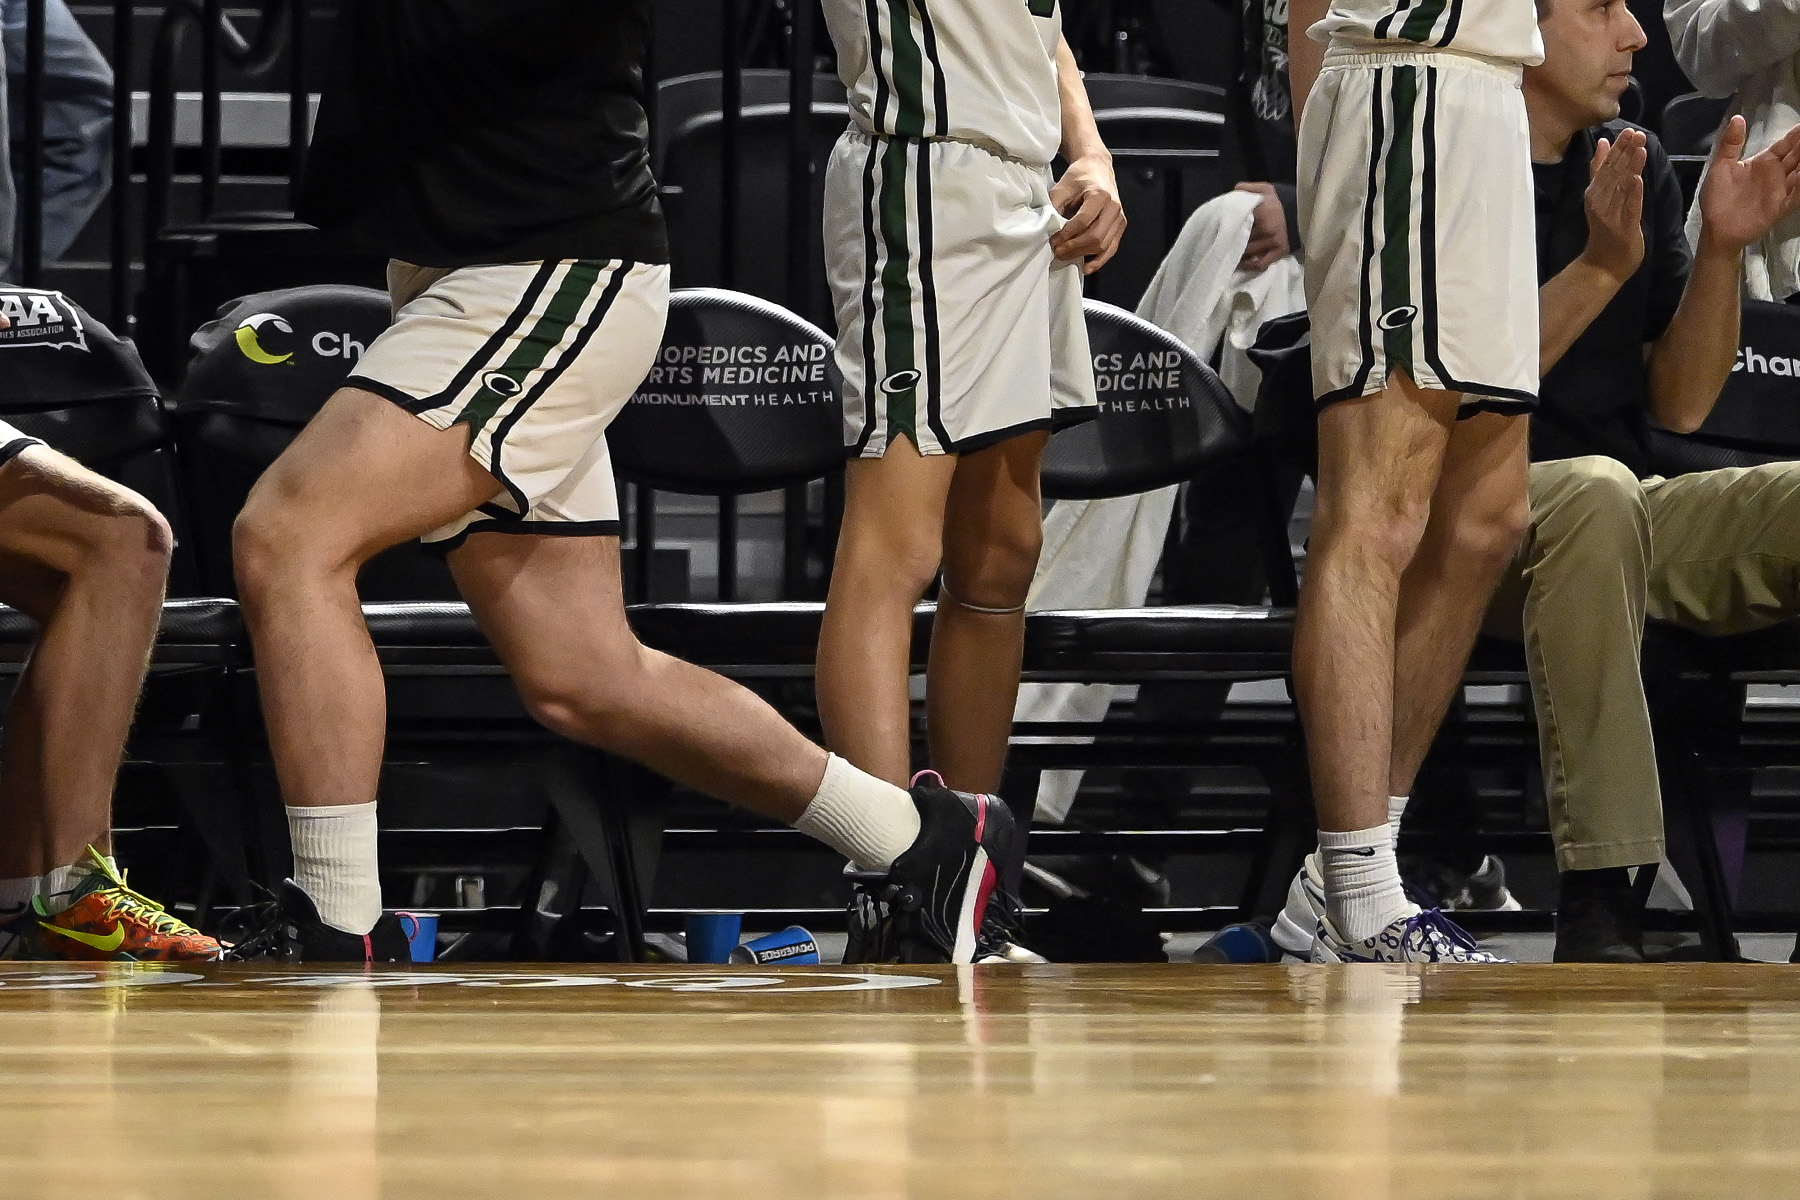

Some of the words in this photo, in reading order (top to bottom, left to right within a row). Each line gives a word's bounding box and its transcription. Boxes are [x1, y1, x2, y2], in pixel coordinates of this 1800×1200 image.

[16, 324, 65, 339] ASSOCIATION
[773, 343, 827, 363] AND
[1129, 351, 1182, 371] AND
[649, 366, 694, 385] RTS
[702, 364, 826, 385] MEDICINE
[1096, 370, 1181, 392] DICINE
[631, 393, 750, 406] MONUMENT
[754, 391, 834, 406] HEALTH
[1111, 396, 1190, 413] HEALTH
